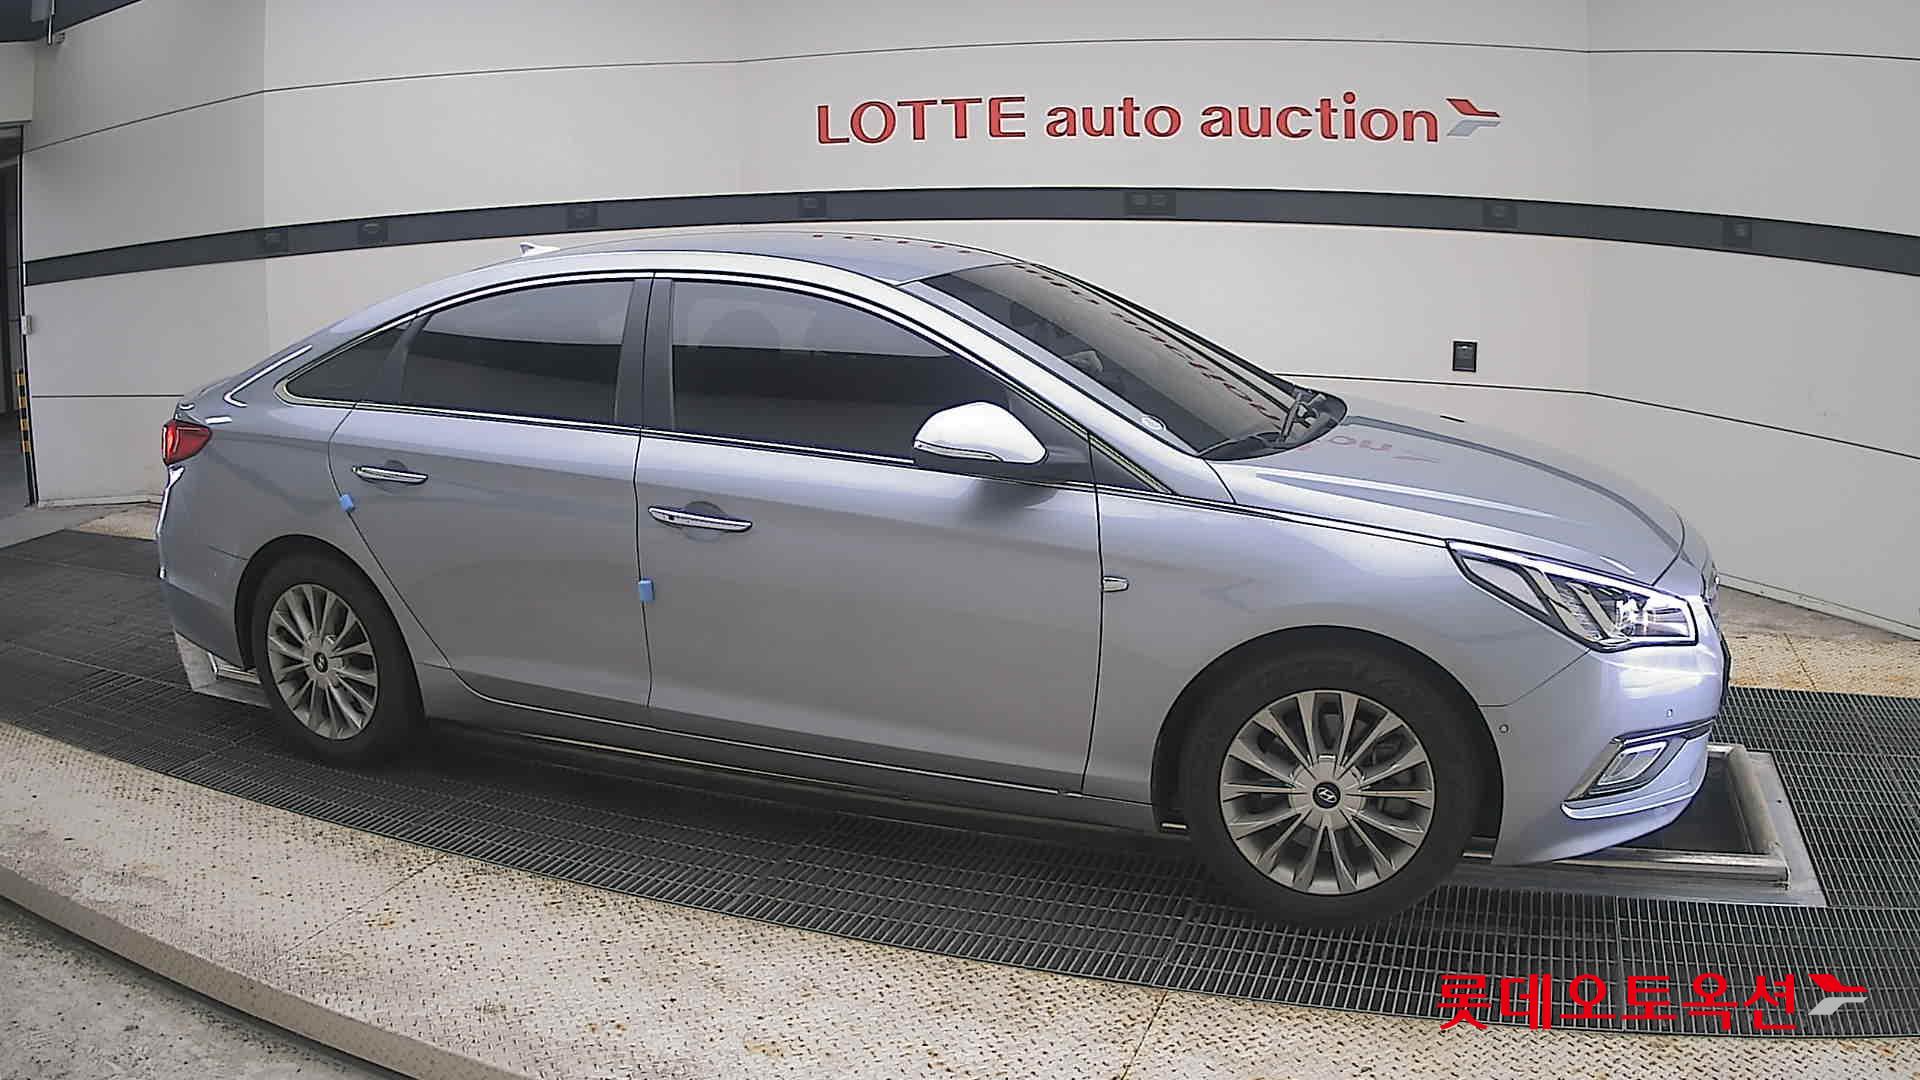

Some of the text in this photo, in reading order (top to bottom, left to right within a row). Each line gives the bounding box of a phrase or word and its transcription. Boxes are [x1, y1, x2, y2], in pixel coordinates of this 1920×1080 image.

[816, 91, 1440, 145] LOTTE auto auction
